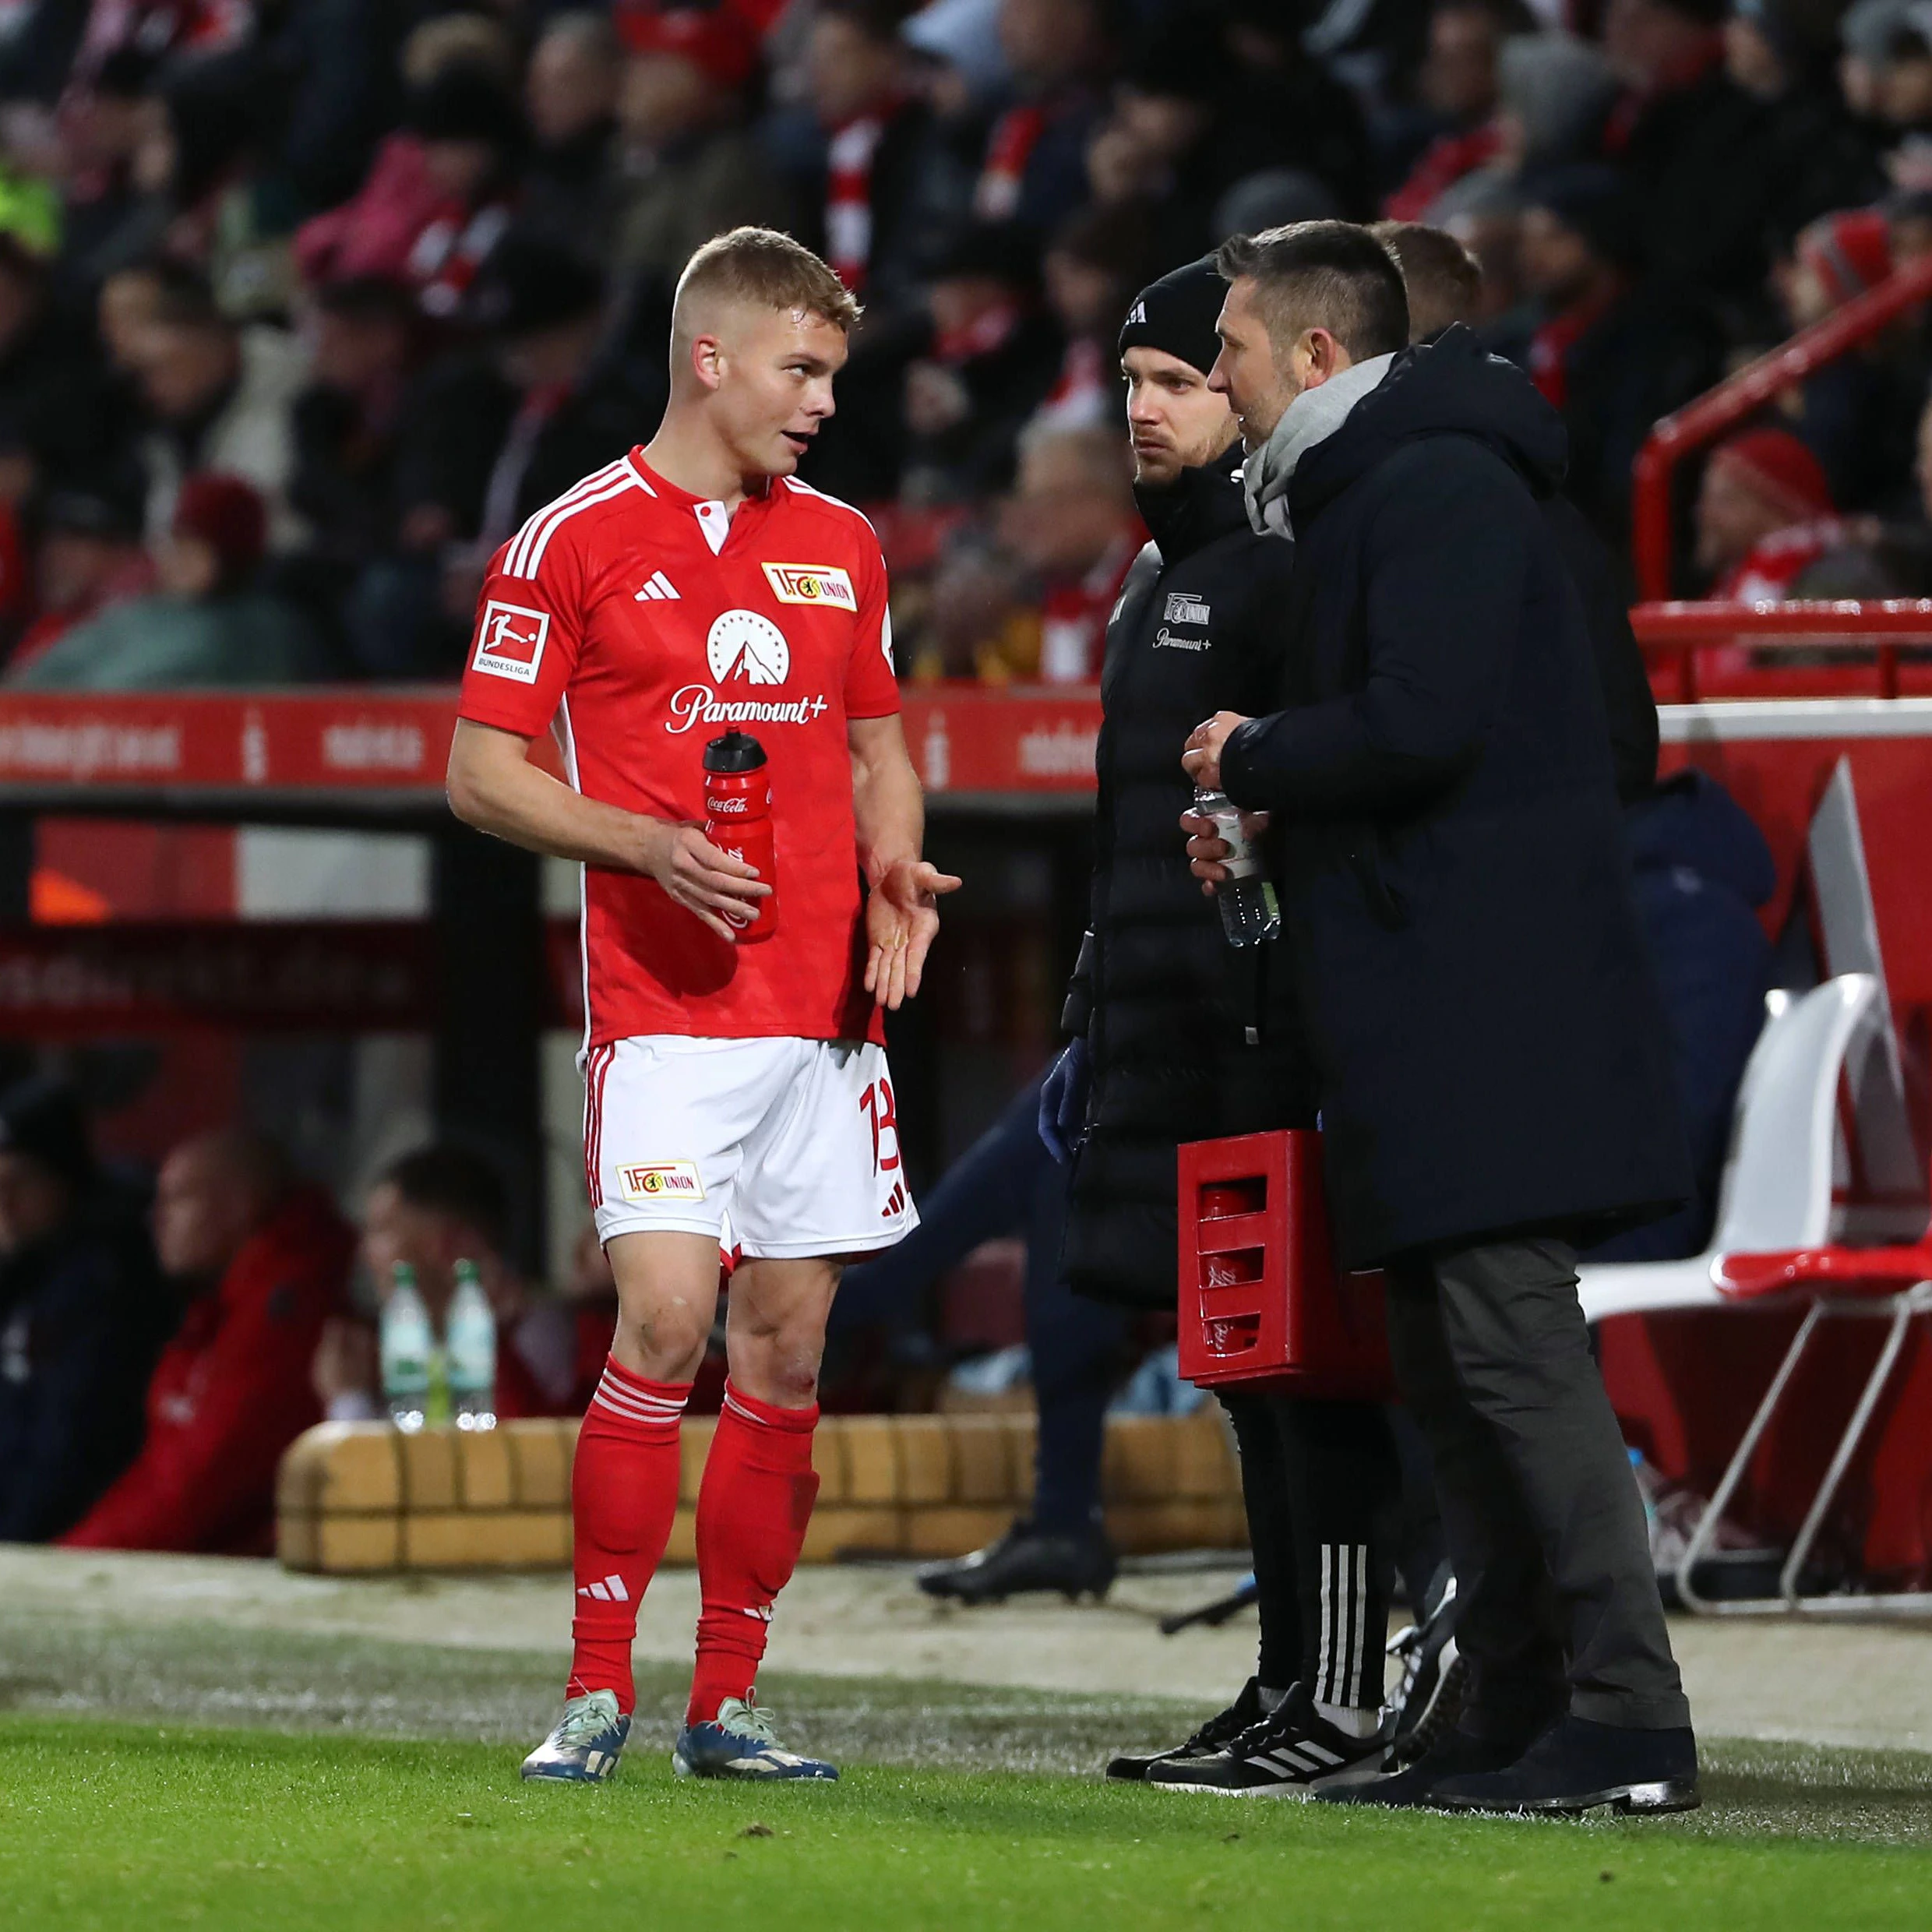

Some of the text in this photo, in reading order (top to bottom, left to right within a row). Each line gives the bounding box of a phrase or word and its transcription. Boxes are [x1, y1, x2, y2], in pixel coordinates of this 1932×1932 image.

[820, 581, 851, 601] UNION
[1152, 627, 1211, 651] Paramount+
[478, 658, 531, 676] BUNDESLIGA
[665, 683, 828, 734] Paramount+
[859, 1076, 899, 1178] 13
[665, 1176, 694, 1190] UNION
